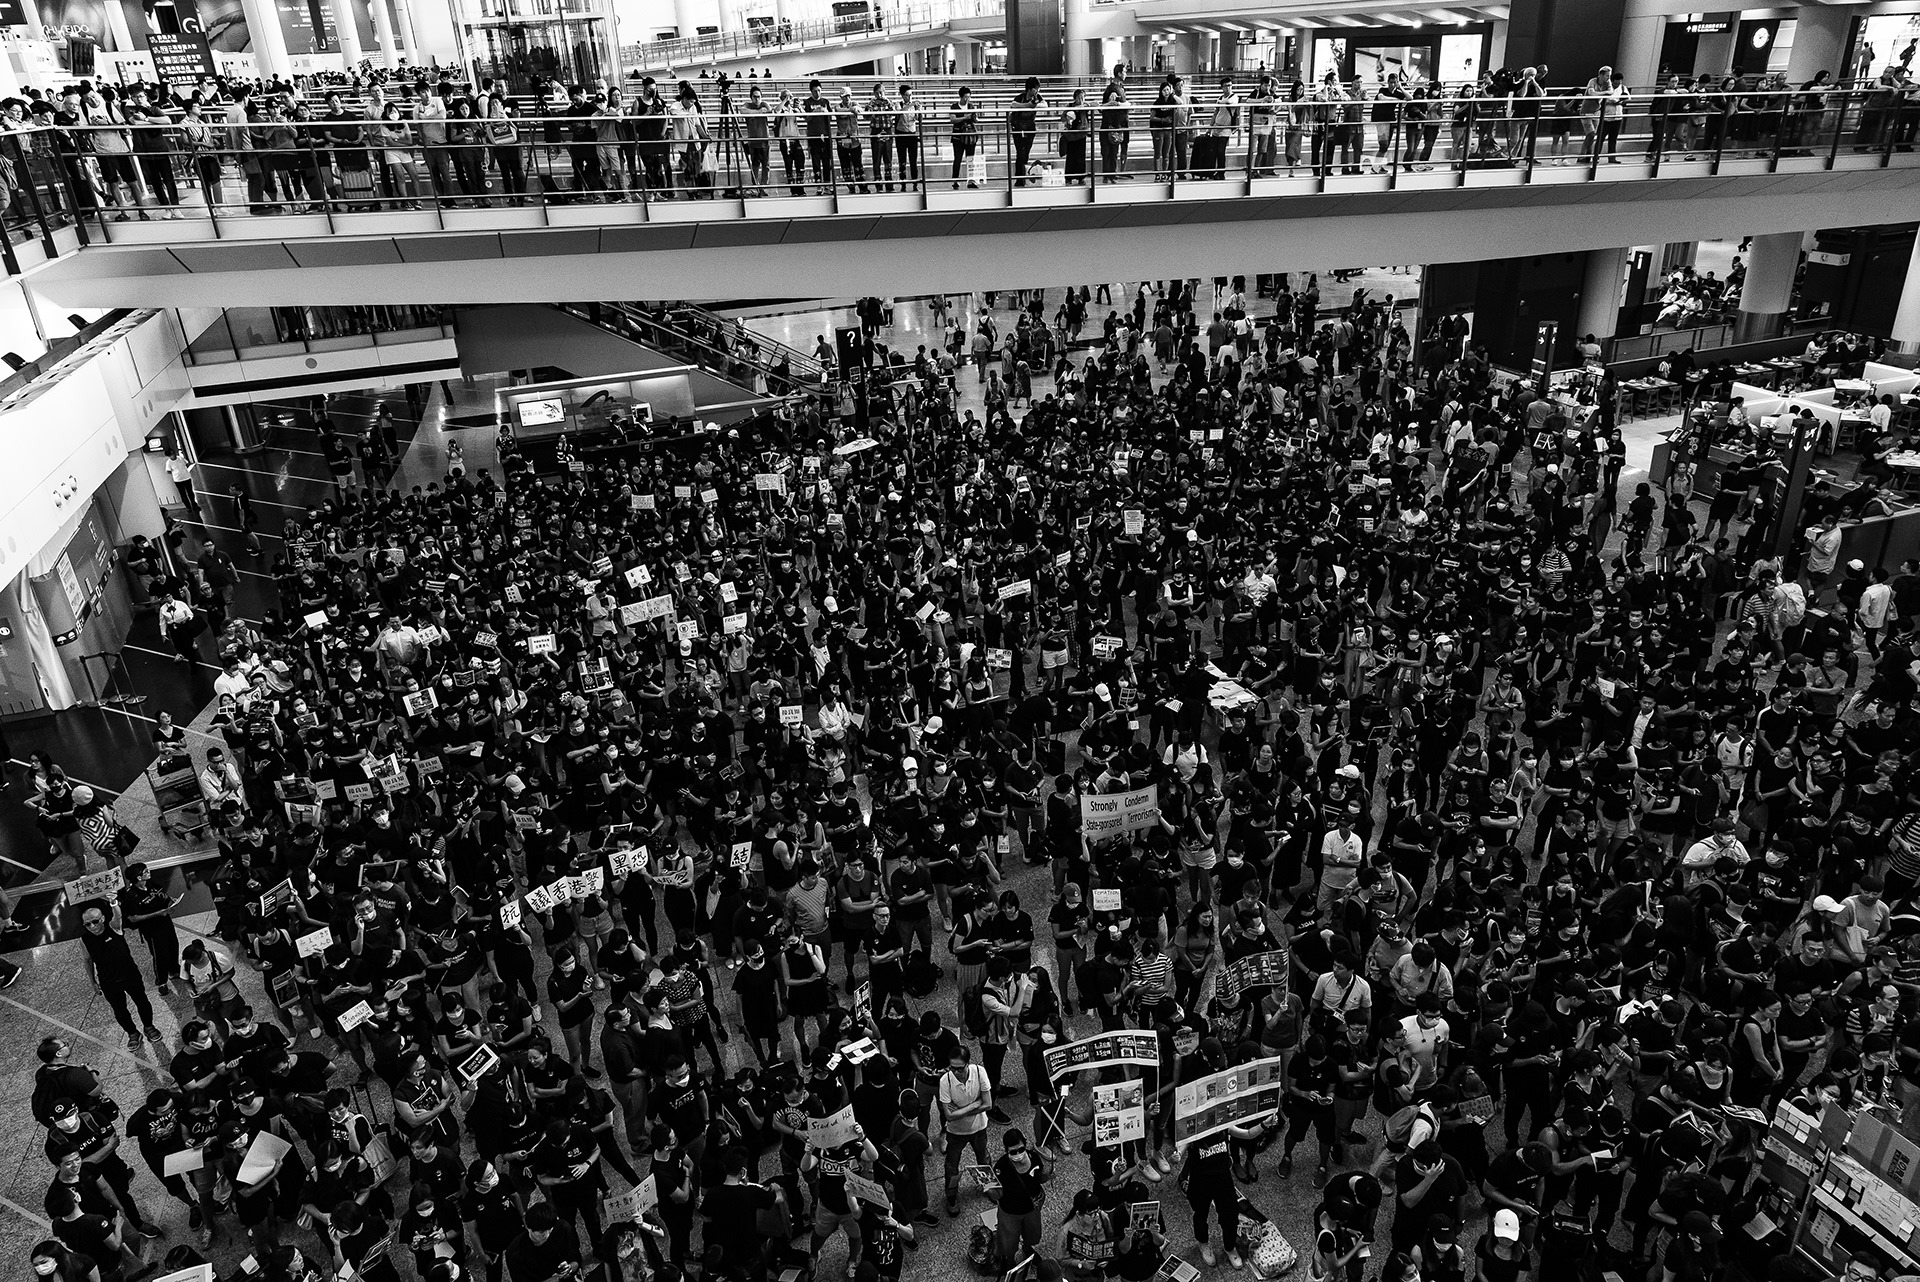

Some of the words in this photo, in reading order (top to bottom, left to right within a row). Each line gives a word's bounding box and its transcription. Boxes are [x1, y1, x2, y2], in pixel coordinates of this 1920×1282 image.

[1091, 799, 1118, 812] Strongly
[1125, 794, 1149, 807] Condemn
[1086, 815, 1123, 831] State-sponsored
[1128, 808, 1154, 824] Terrorism
[732, 848, 749, 865] 結
[502, 905, 520, 924] 抗
